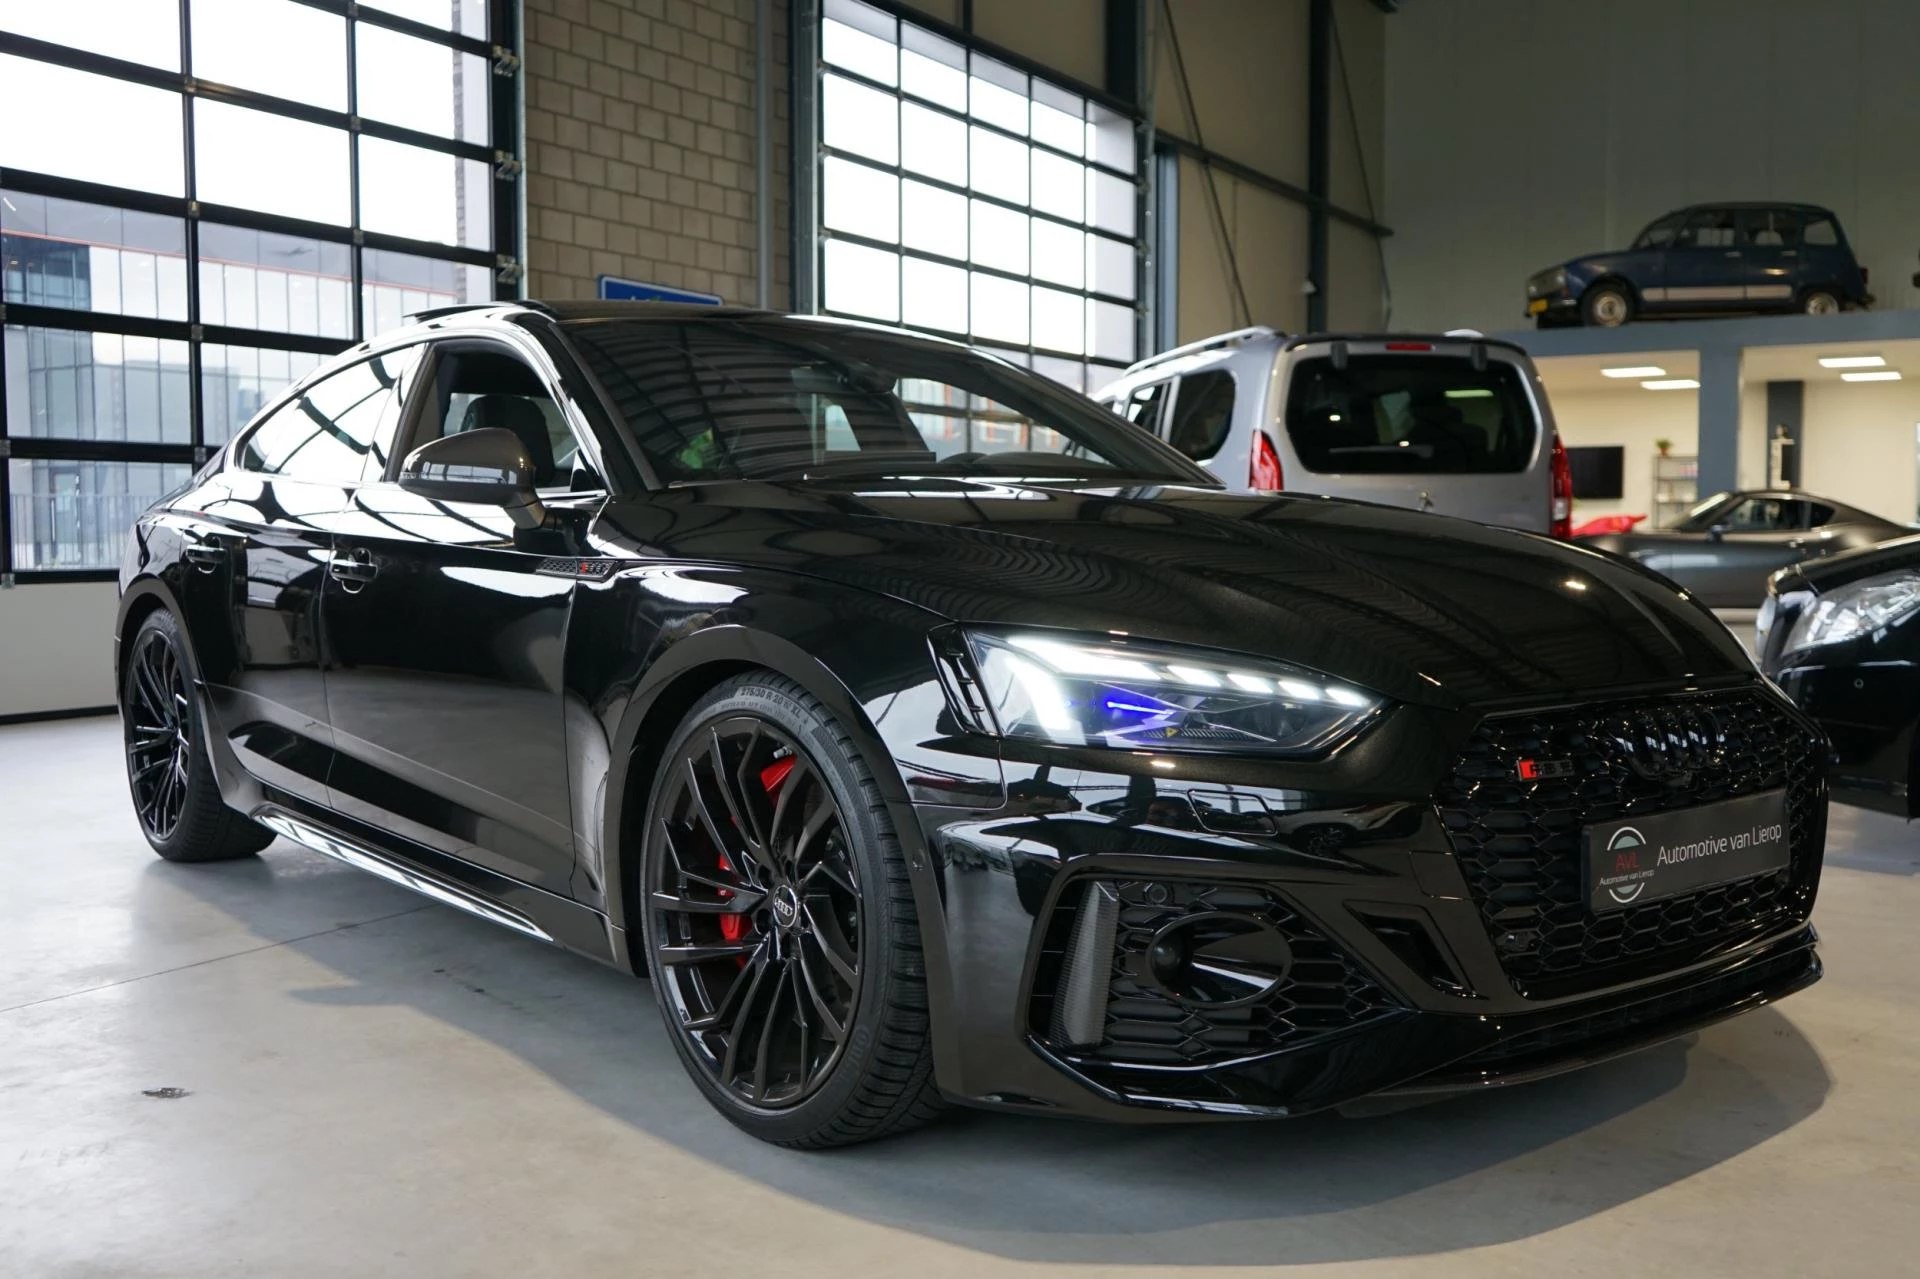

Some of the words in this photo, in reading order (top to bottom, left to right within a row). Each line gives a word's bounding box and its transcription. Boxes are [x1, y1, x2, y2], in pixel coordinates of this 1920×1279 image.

[773, 694, 784, 705] 20
[1656, 835, 1728, 867] Automotive
[1729, 832, 1751, 851] van
[1752, 823, 1782, 846] Lierop
[1615, 852, 1640, 872] AVL
